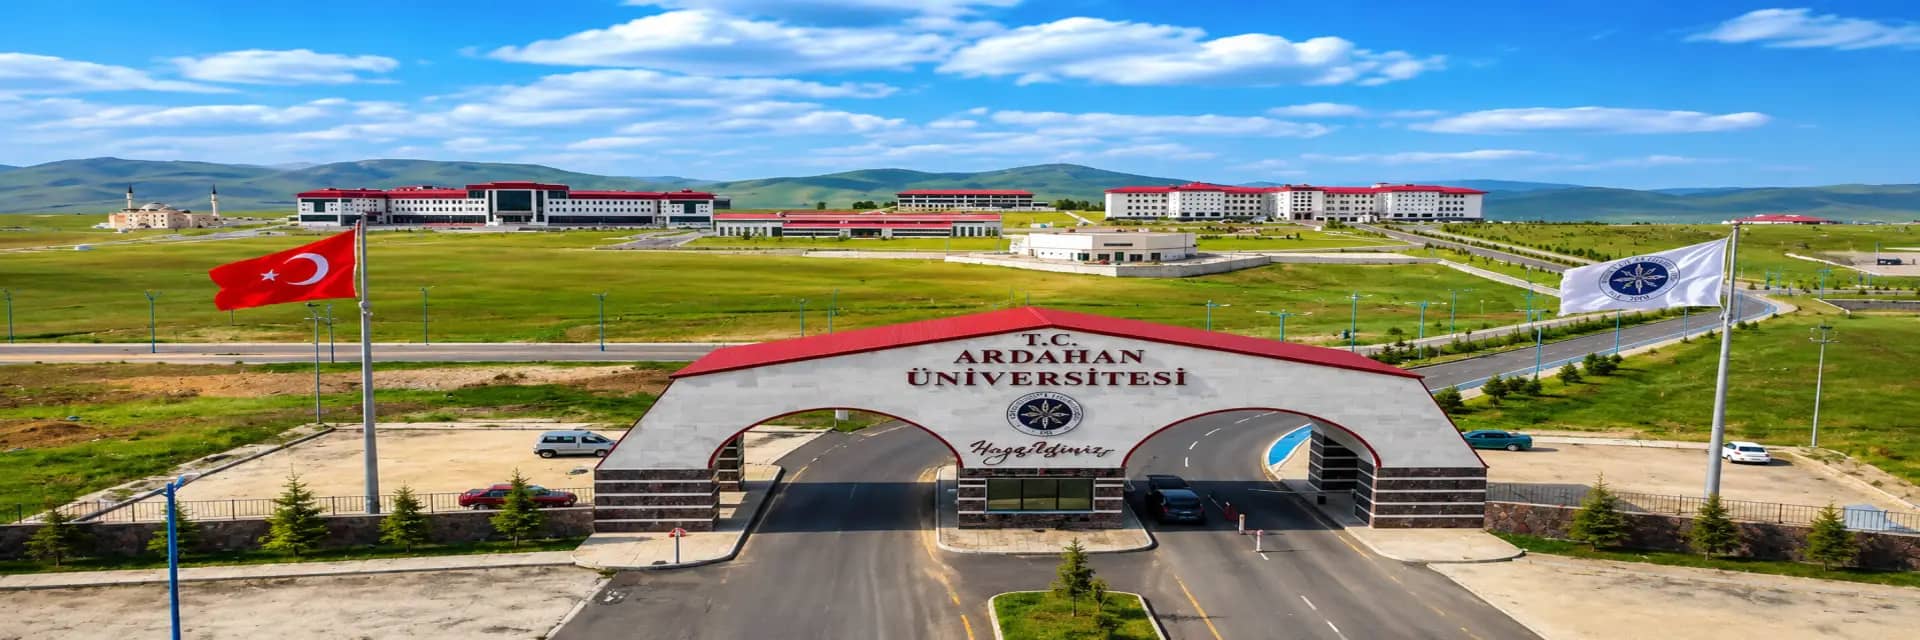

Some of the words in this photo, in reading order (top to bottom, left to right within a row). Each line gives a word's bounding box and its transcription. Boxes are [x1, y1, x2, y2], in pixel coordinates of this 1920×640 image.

[1022, 333, 1077, 347] T.C.
[954, 349, 1145, 365] ARDAHAN
[907, 367, 1188, 387] ÜNİVERSİTESİ
